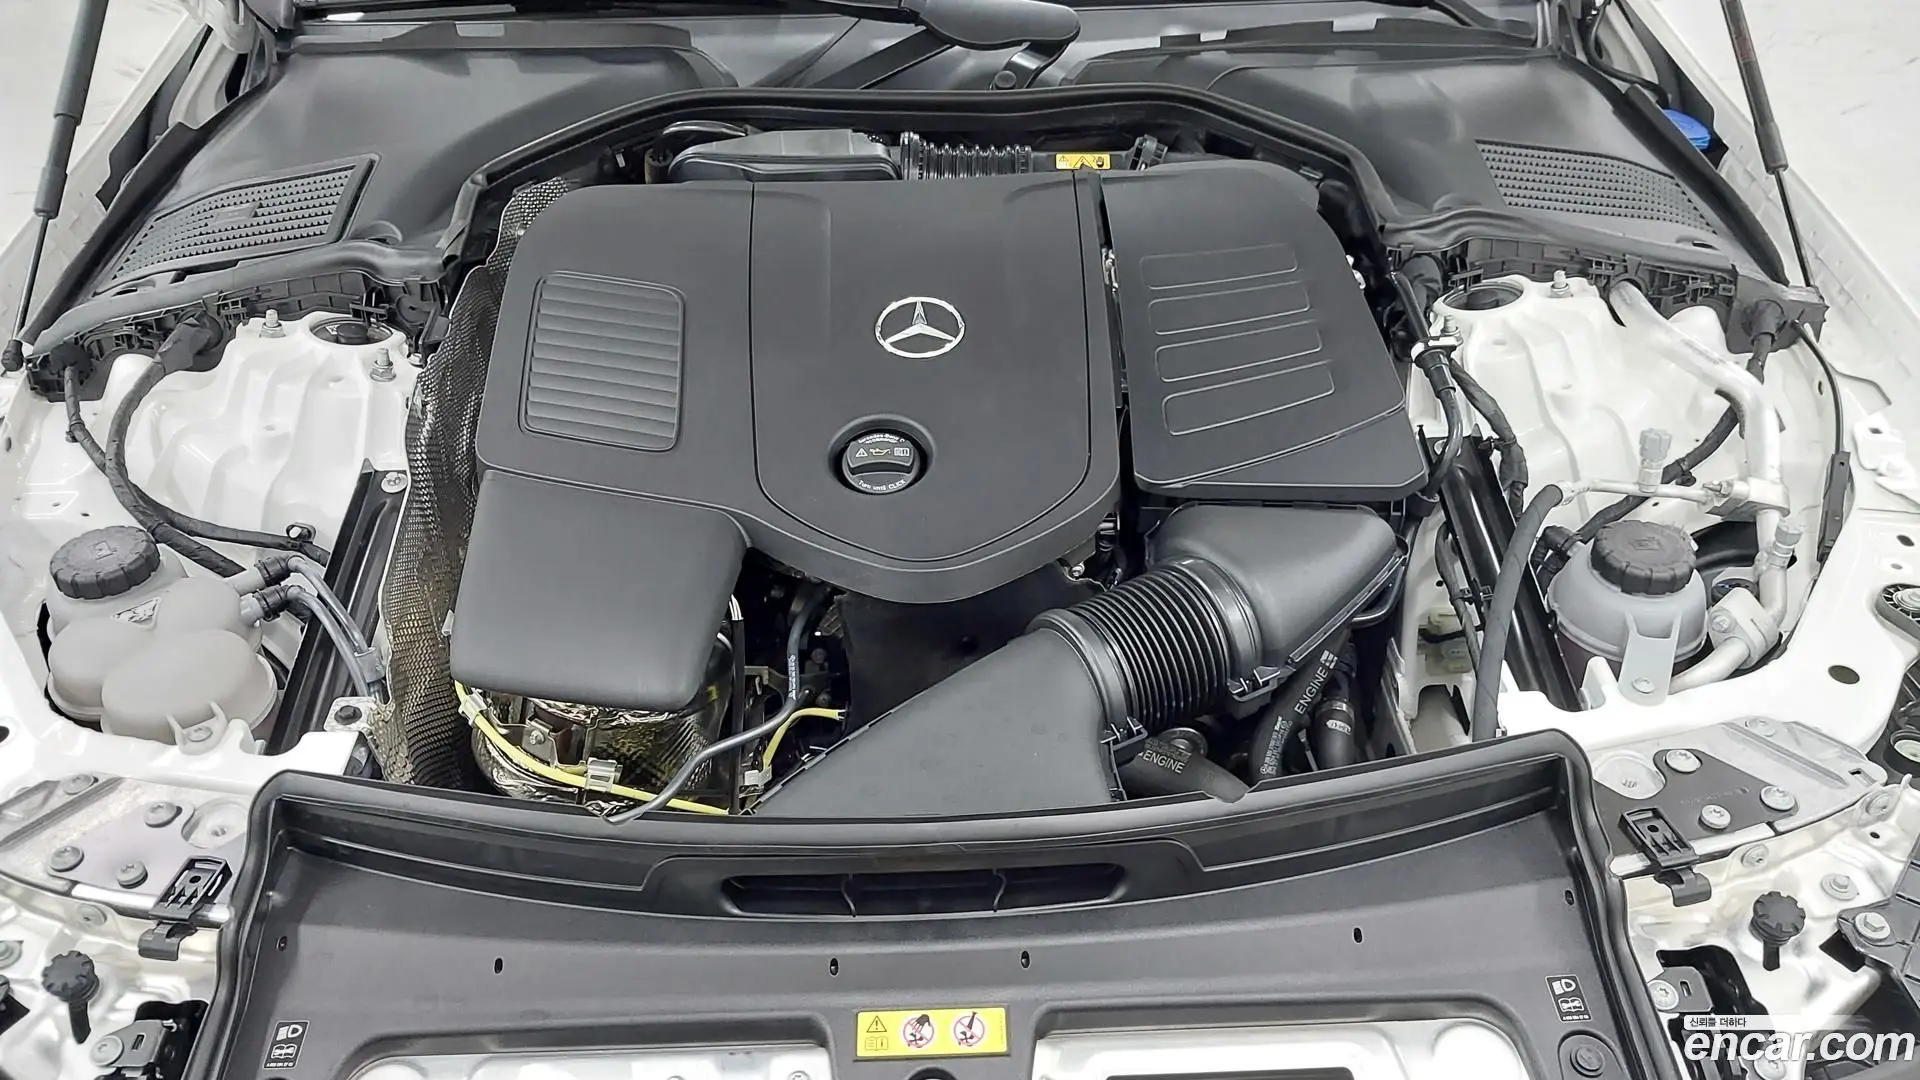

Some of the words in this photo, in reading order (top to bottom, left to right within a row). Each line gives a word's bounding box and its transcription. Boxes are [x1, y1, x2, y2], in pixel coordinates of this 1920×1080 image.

[888, 479, 906, 490] CLICK
[1294, 666, 1328, 715] ENGINE
[1142, 749, 1185, 774] ENGINE
